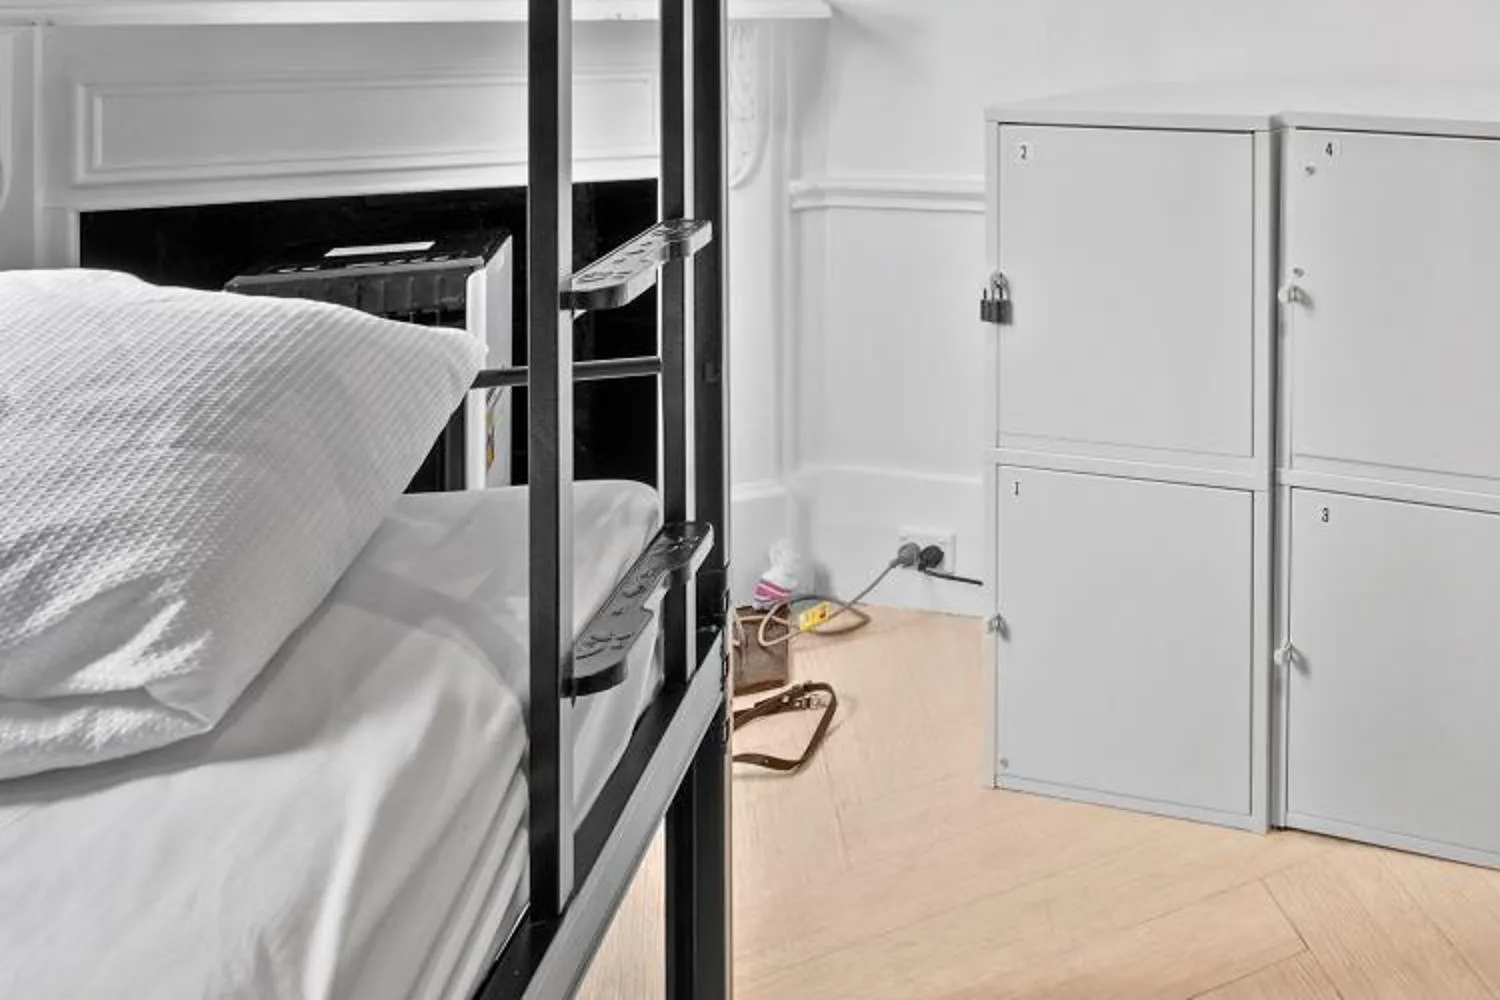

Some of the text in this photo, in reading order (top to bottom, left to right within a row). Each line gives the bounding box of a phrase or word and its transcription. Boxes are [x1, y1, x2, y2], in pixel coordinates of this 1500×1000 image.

[1020, 144, 1027, 160] 2
[1325, 142, 1333, 157] 4
[1321, 507, 1329, 523] 3
